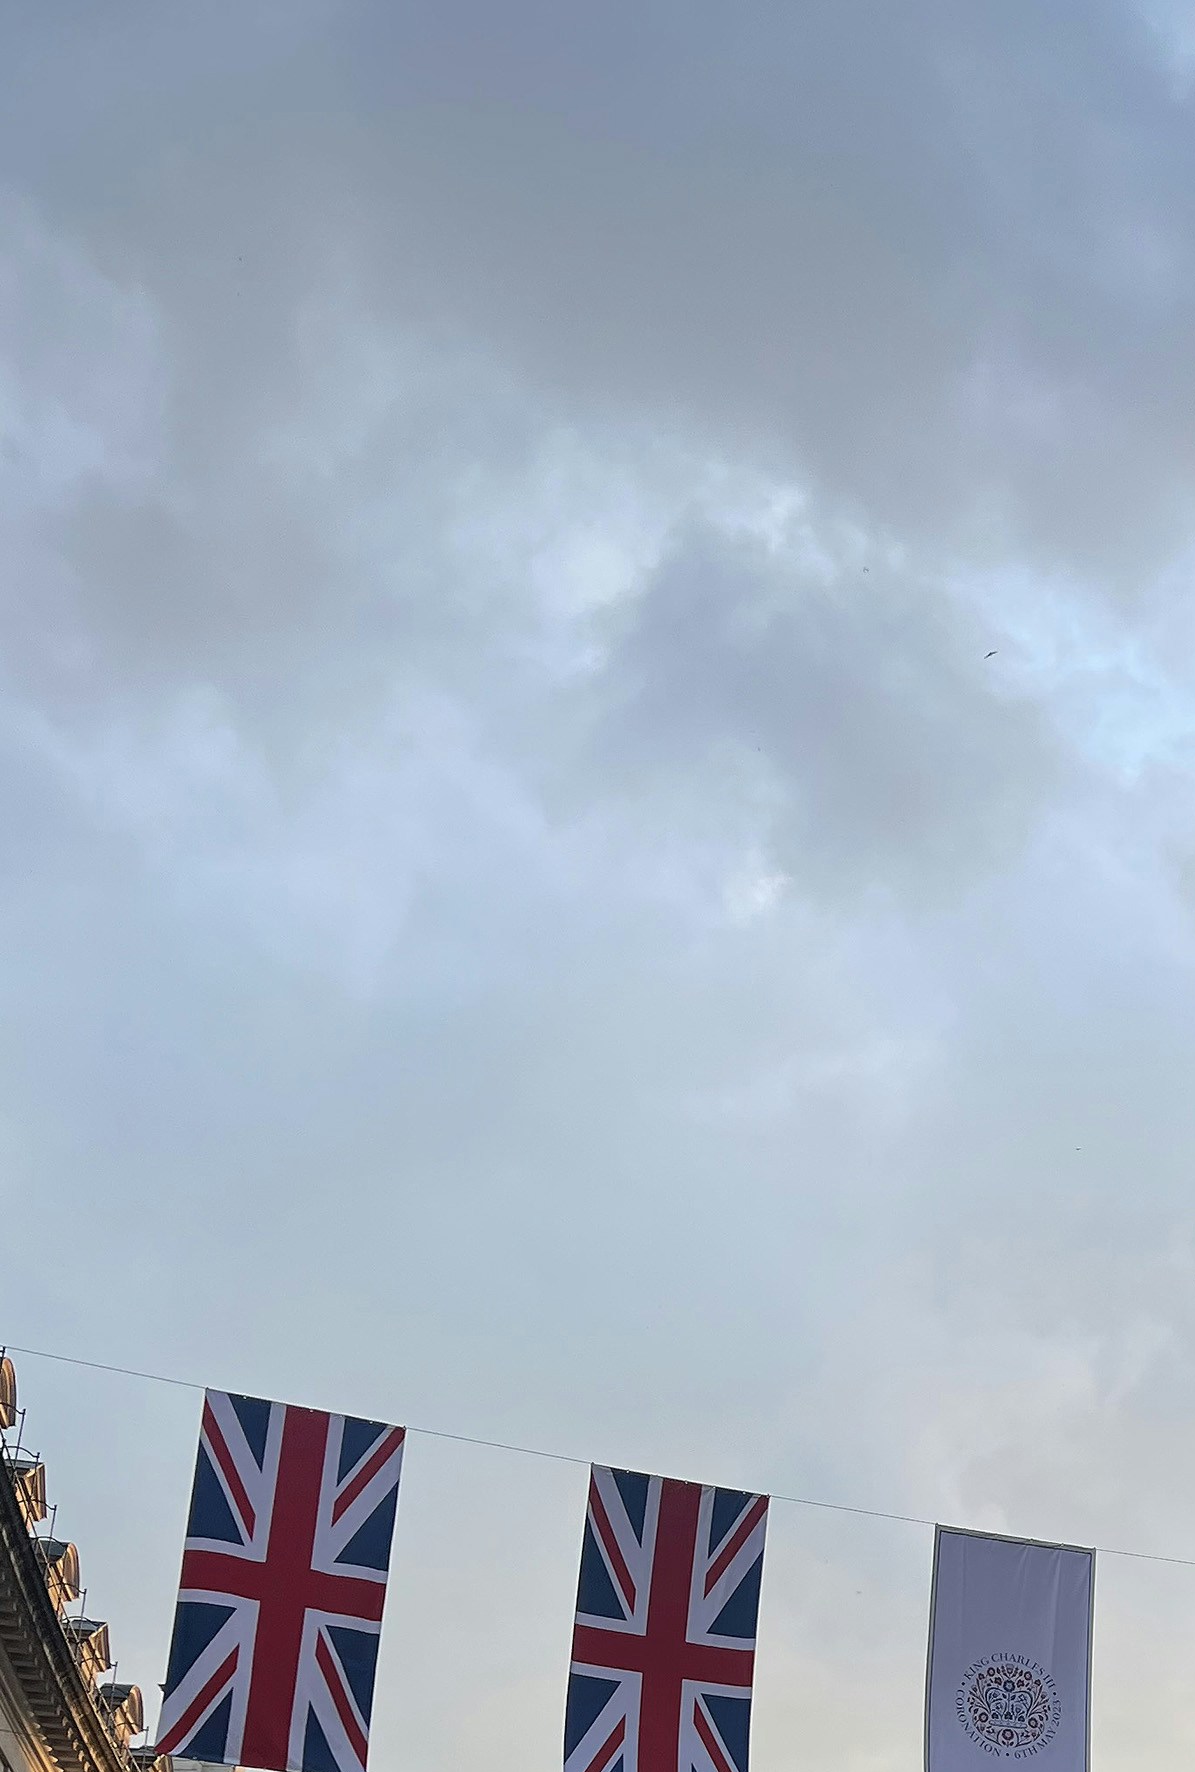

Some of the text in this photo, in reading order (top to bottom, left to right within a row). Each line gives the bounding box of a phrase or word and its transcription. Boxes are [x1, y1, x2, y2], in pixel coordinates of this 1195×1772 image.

[963, 1653, 1056, 1689] KING CHARLES III
[955, 1689, 1001, 1757] CORONATION
[1014, 1745, 1038, 1760] 6TH
[1036, 1727, 1057, 1748] MAY
